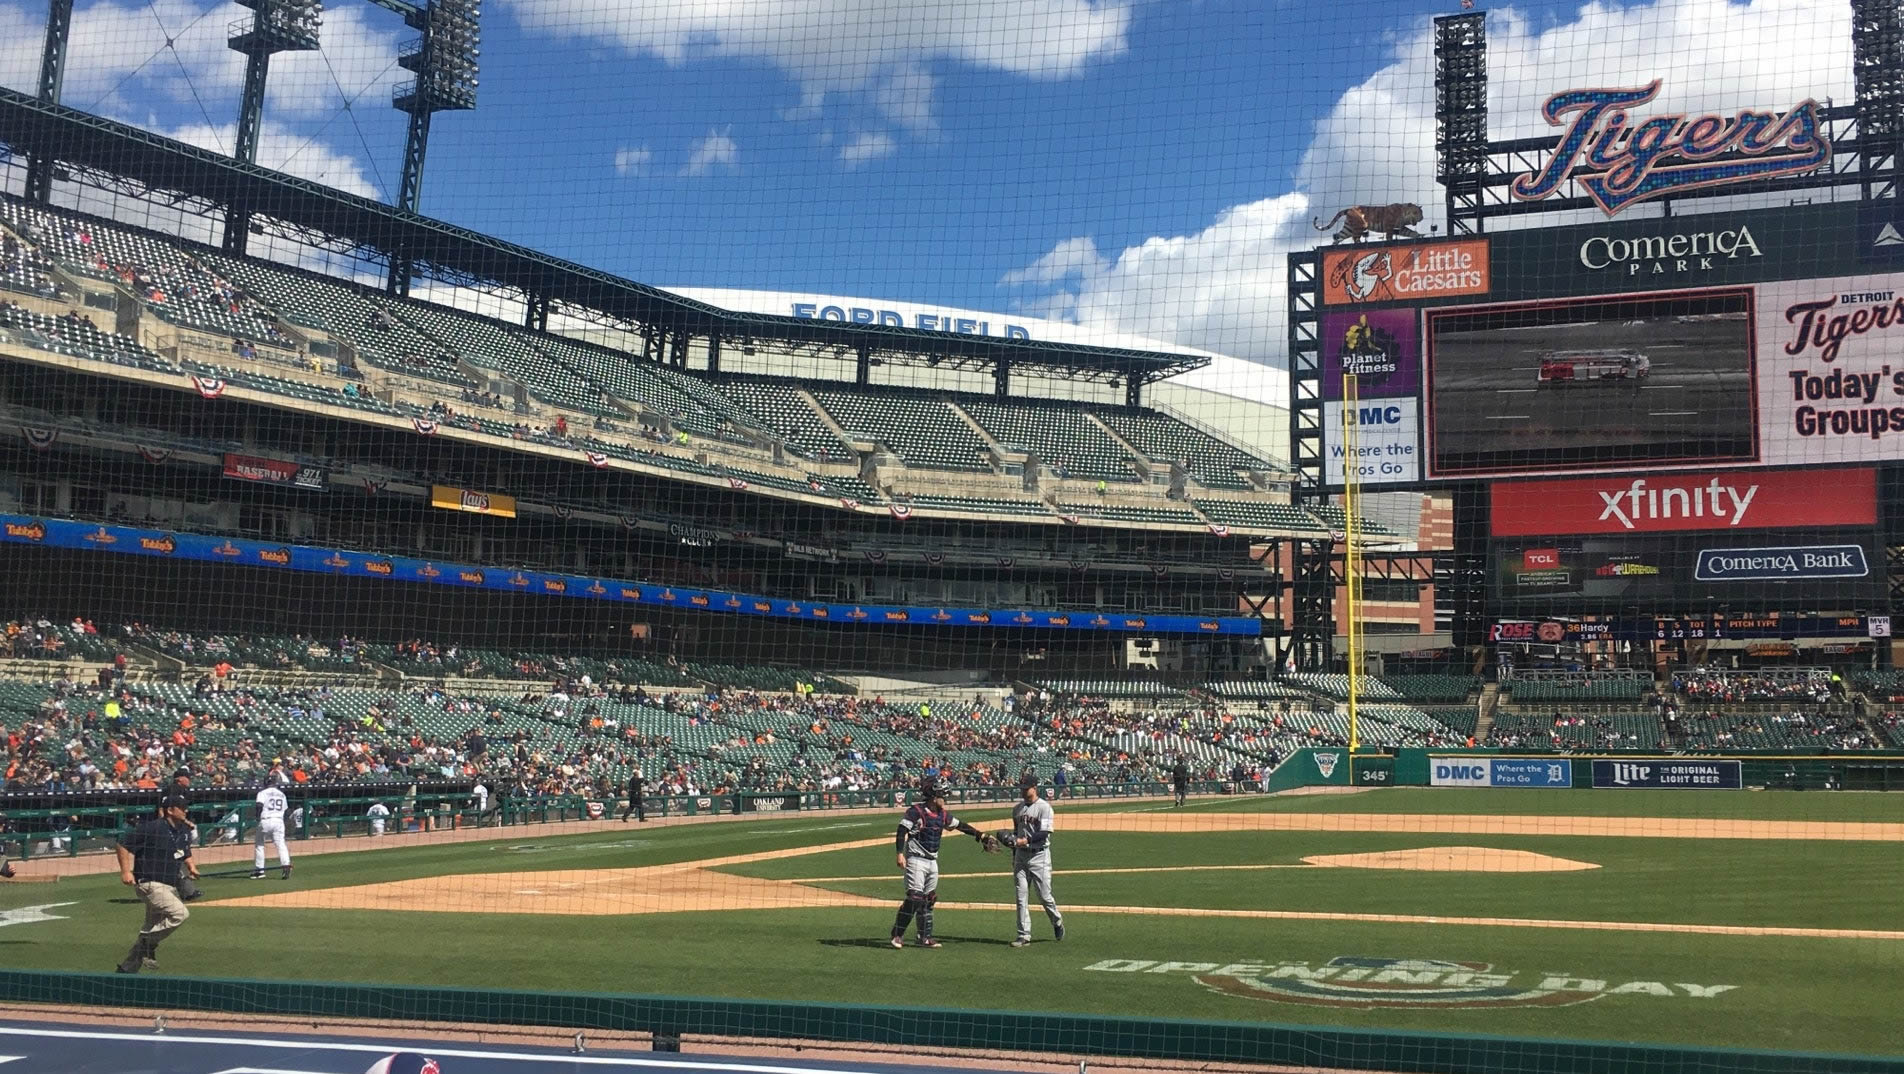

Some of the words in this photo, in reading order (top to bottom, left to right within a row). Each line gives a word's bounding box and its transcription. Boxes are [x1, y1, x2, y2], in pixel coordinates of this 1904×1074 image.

[1512, 78, 1832, 218] Tigers
[1413, 248, 1472, 272] Little
[1630, 257, 1713, 276] PARK
[1395, 269, 1481, 293] Caesars
[1841, 291, 1895, 304] DETROIT
[792, 303, 904, 327] FORD
[1785, 295, 1904, 363] Tigers
[1343, 353, 1387, 367] planet
[1350, 362, 1396, 374] fitness
[1789, 365, 1904, 404] Today's
[1342, 406, 1400, 426] DMC
[1795, 405, 1904, 440] Groups
[1331, 445, 1381, 458] Where
[1386, 443, 1413, 455] the
[1381, 462, 1403, 474] Go
[1598, 477, 1759, 529] xfinity
[671, 523, 720, 541] CHAMPIONS
[1529, 555, 1554, 563] TCL
[1803, 552, 1853, 568] Bank
[1568, 624, 1581, 632] 36
[1581, 623, 1609, 633] Hardy
[1730, 620, 1754, 628] PITCH
[1839, 618, 1859, 626] MPH
[1870, 617, 1889, 625] MVR
[1489, 623, 1534, 641] ROSE
[1658, 630, 1665, 638] 6
[1672, 630, 1684, 638] 12
[1691, 629, 1704, 638] 18
[1876, 625, 1884, 635] 5
[1436, 765, 1484, 780] DMC
[1497, 764, 1524, 773] Where
[1527, 765, 1542, 773] the
[1613, 763, 1651, 785] Lite
[1671, 766, 1720, 775] ORIGINAL
[1497, 774, 1516, 783] Pros
[1518, 774, 1531, 783] Go
[1660, 775, 1690, 783] LIGHT
[1693, 775, 1720, 783] BEER
[268, 798, 283, 811] 39
[753, 797, 785, 806] OAKLAND
[1082, 959, 1513, 987] OPENING
[1538, 973, 1741, 998] DAY
